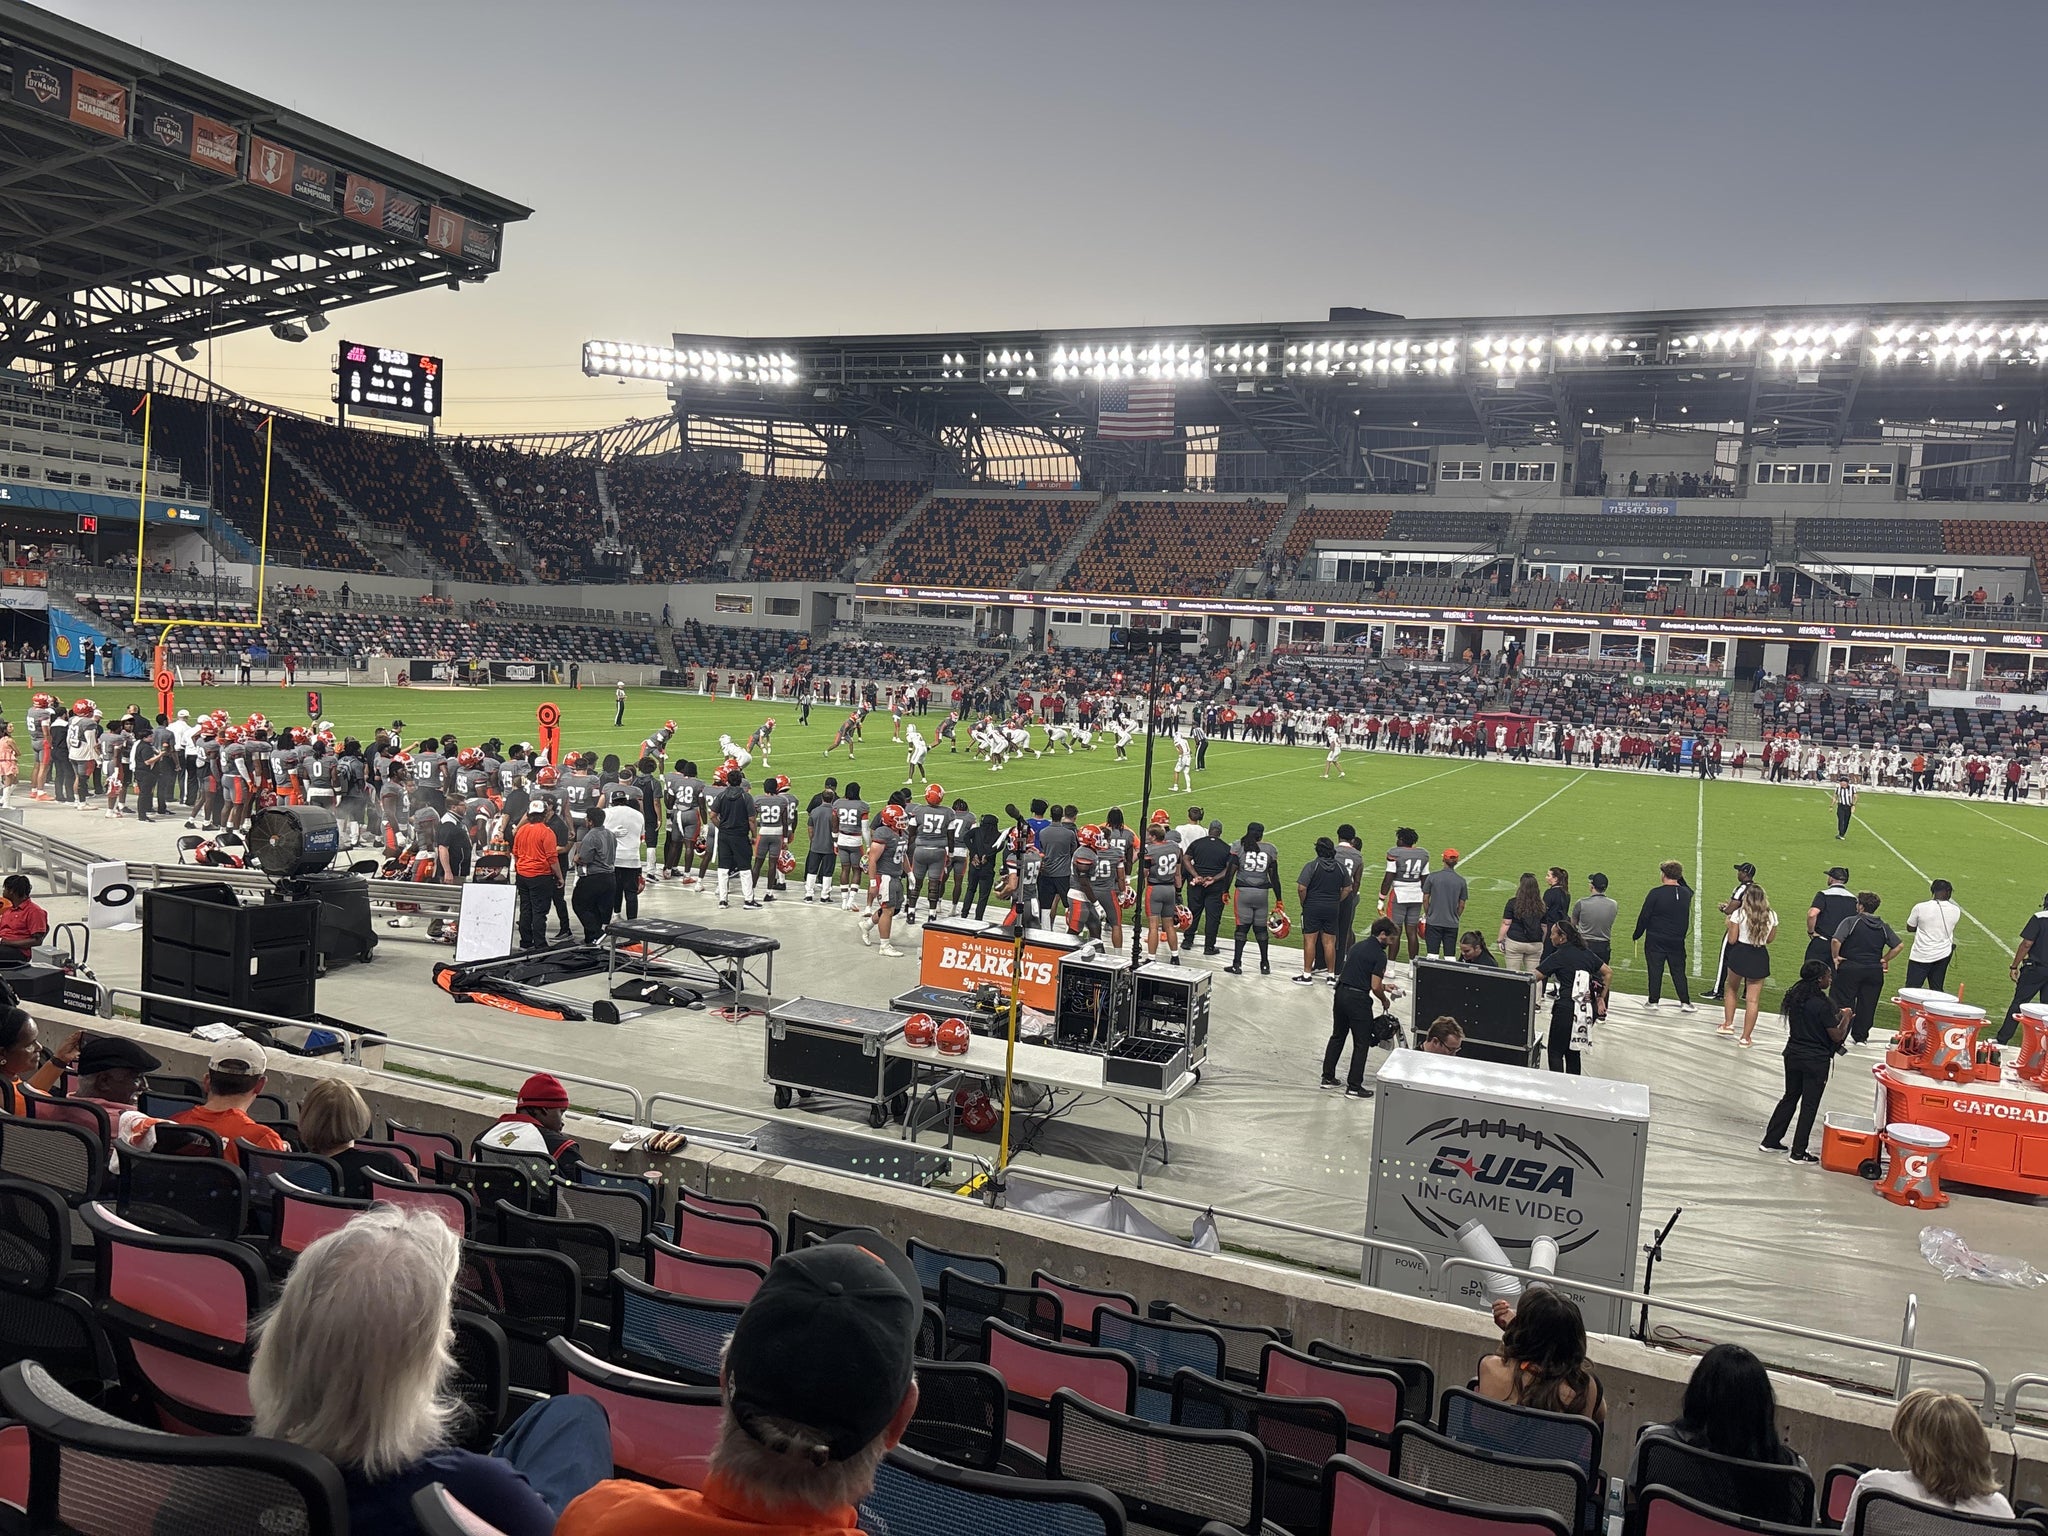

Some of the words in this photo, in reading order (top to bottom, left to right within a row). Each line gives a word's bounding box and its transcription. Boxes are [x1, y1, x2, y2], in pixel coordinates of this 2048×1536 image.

[29, 79, 57, 96] DYNAMO
[77, 101, 120, 123] CHAMPIONS
[156, 126, 180, 140] DYNAMO
[196, 144, 231, 164] CHAMPIONS
[301, 164, 327, 185] 2018
[294, 183, 331, 202] CHAMPIONS
[353, 195, 375, 207] DASH
[463, 245, 490, 260] CHAMPIONS
[346, 352, 367, 362] STATE
[378, 348, 408, 366] 13:53
[84, 517, 95, 531] 14
[227, 575, 243, 585] THE
[1487, 614, 1517, 623] Advancing
[1519, 615, 1541, 624] health.
[1542, 616, 1582, 626] Personalizing
[1584, 618, 1600, 626] care.
[1660, 621, 1694, 631] Advancing
[1695, 623, 1719, 632] health.
[1720, 624, 1764, 633] Personalizing
[1766, 626, 1783, 634] care.
[1851, 630, 1889, 639] Advancing
[1890, 631, 1916, 640] health.
[1917, 632, 1967, 642] Personalizing
[1968, 634, 1986, 643] care.
[309, 692, 318, 712] 3
[312, 761, 322, 777] 0
[417, 761, 431, 779] 19
[566, 786, 585, 803] 97
[760, 805, 781, 823] 29
[838, 808, 858, 825] 26
[922, 813, 945, 834] 57
[1157, 853, 1177, 876] 82
[1243, 851, 1268, 873] 59
[1402, 859, 1422, 879] 14
[961, 942, 981, 952] SAM
[985, 945, 1033, 960] HOUSN
[63, 990, 80, 999] ECTION
[67, 999, 87, 1009] SECTION
[1944, 1028, 1966, 1050] G
[1953, 1099, 2048, 1124] GATORAD
[1904, 1155, 1928, 1177] G
[1417, 1182, 1510, 1213] IN-GAME
[1514, 1199, 1584, 1226] VIDEO
[1395, 1258, 1423, 1271] POWE
[1461, 1286, 1483, 1298] SPO
